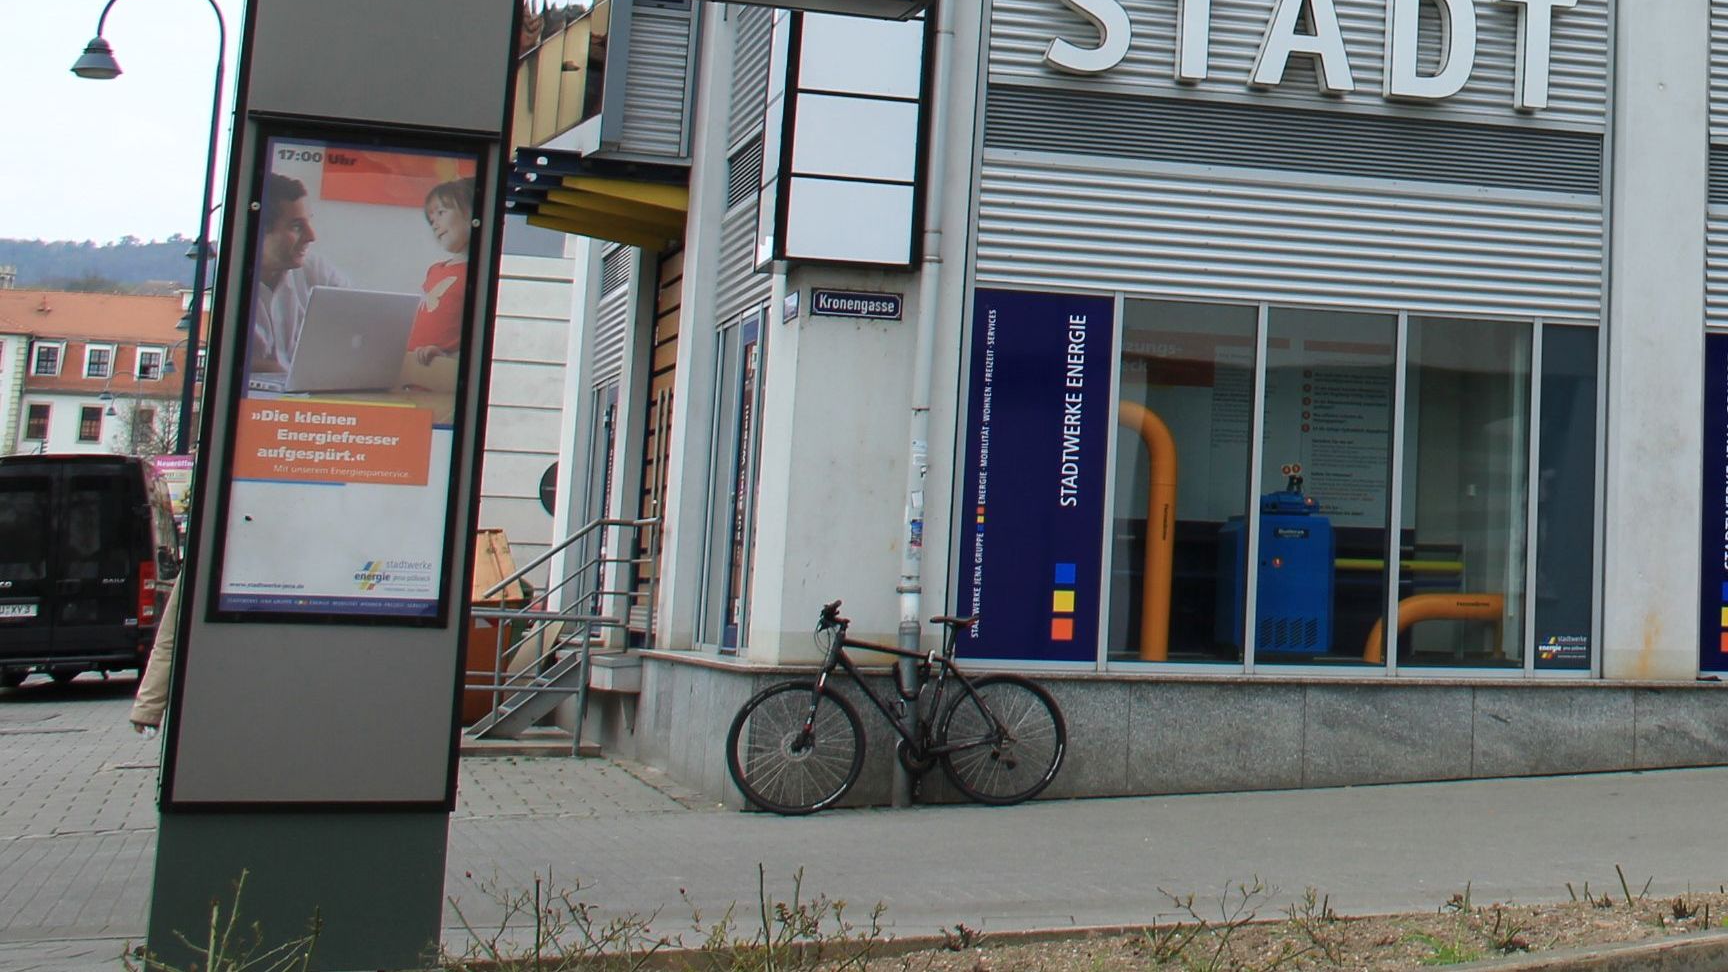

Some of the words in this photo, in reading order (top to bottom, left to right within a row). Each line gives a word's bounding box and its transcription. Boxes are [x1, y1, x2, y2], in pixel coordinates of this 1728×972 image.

[278, 149, 322, 163] 17:00
[328, 153, 357, 166] Uhr
[819, 294, 895, 315] Kronengasse
[988, 309, 997, 345] SERVICES
[985, 349, 994, 382] FREIZEIT
[1066, 314, 1087, 388] ENERGIE
[252, 410, 289, 422] »Die
[295, 411, 357, 425] kleinen
[983, 385, 992, 422] WOHNEN
[277, 429, 400, 446] Energiefresser
[980, 425, 990, 467] MOBILITÄT
[1060, 393, 1083, 507] STADTWERKE
[257, 446, 367, 462] aufgespürt.«
[978, 470, 987, 505] ENERGIE
[975, 532, 984, 564] GRUPPE
[354, 572, 391, 583] energie
[386, 560, 432, 570] stadtwerke
